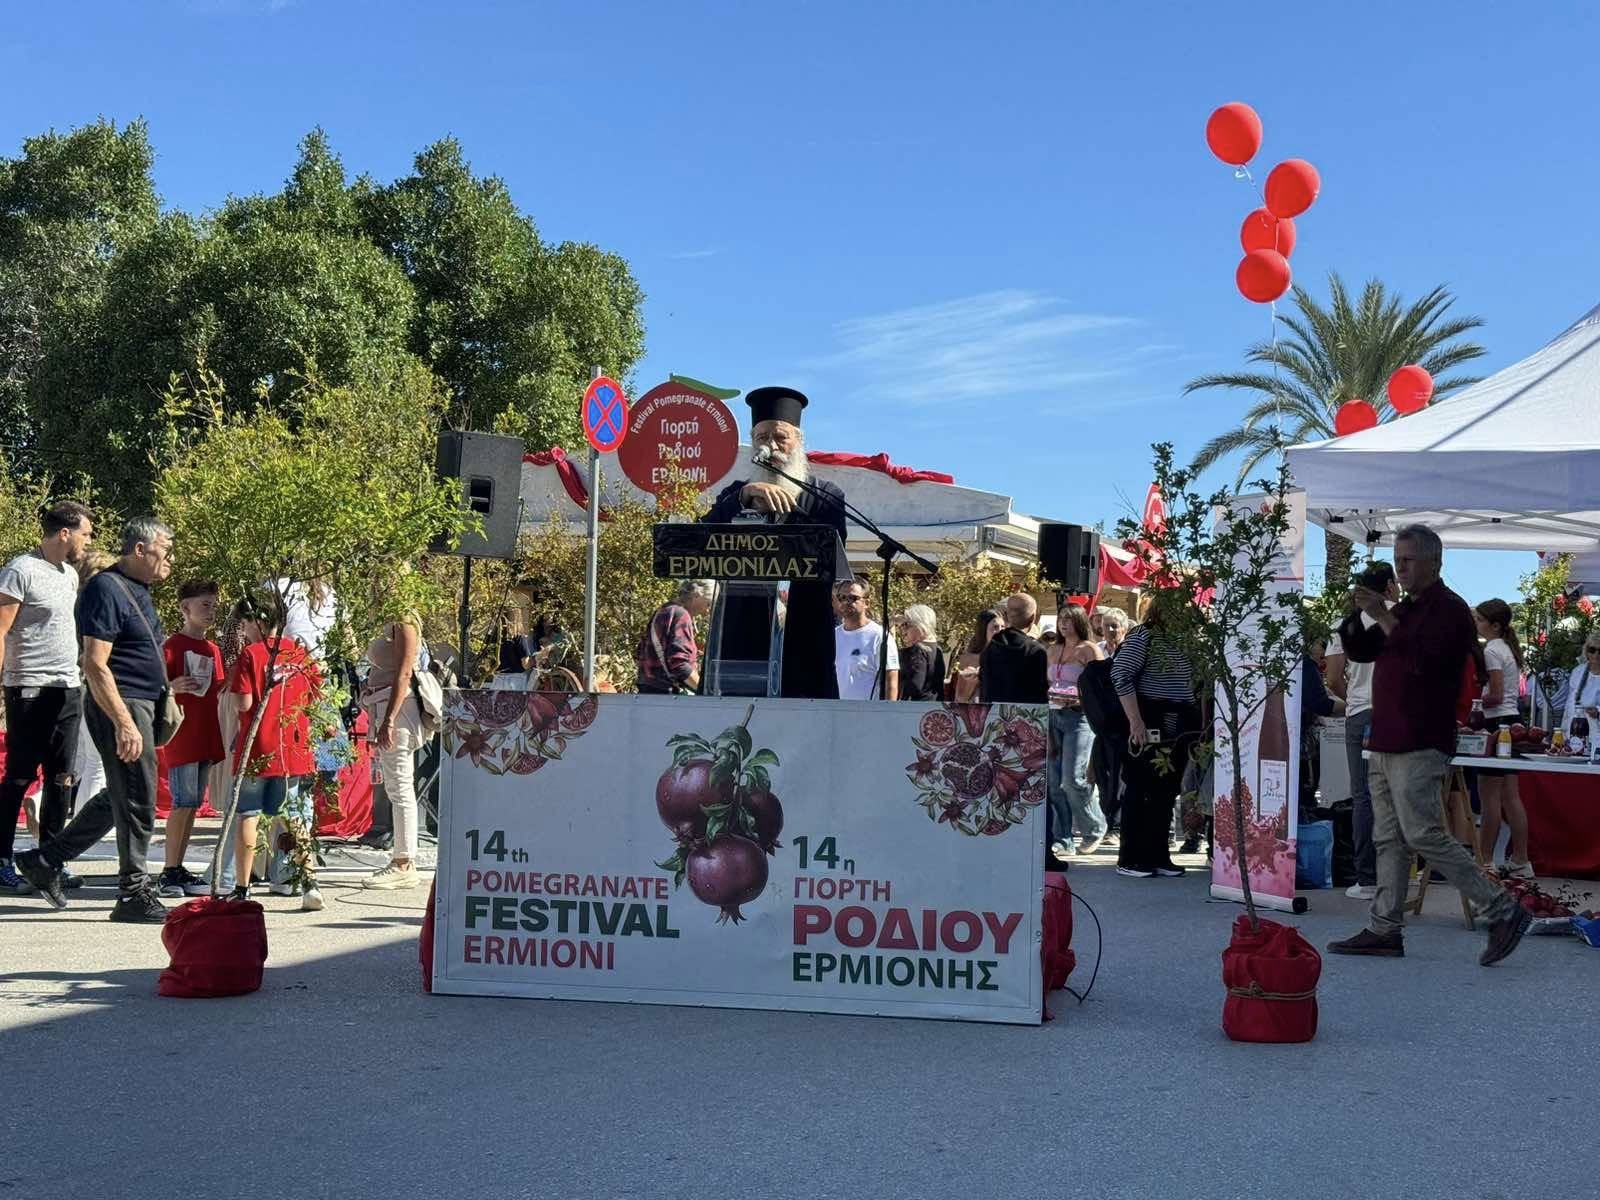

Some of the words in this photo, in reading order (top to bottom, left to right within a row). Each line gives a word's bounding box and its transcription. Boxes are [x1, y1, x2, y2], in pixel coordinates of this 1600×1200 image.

[630, 402, 655, 434] Festival
[653, 394, 707, 410] Pomegranate
[706, 402, 731, 433] Ermioni
[661, 416, 699, 439] Γιορτή
[706, 535, 780, 551] ΔΗΜΟΣ
[669, 556, 819, 578] ΕΡΜΙΟΝΙΔΑΣ
[466, 869, 669, 900] POMEGRANATE
[794, 877, 891, 902] ΓΙΟΡΤΗ
[464, 895, 680, 939] FESTIVAL
[793, 904, 1025, 954] ΡΟΔΙΟΥ
[463, 934, 615, 970] ERMIONI
[792, 951, 1000, 991] ΕΡΜΙΟΝΗΣ
